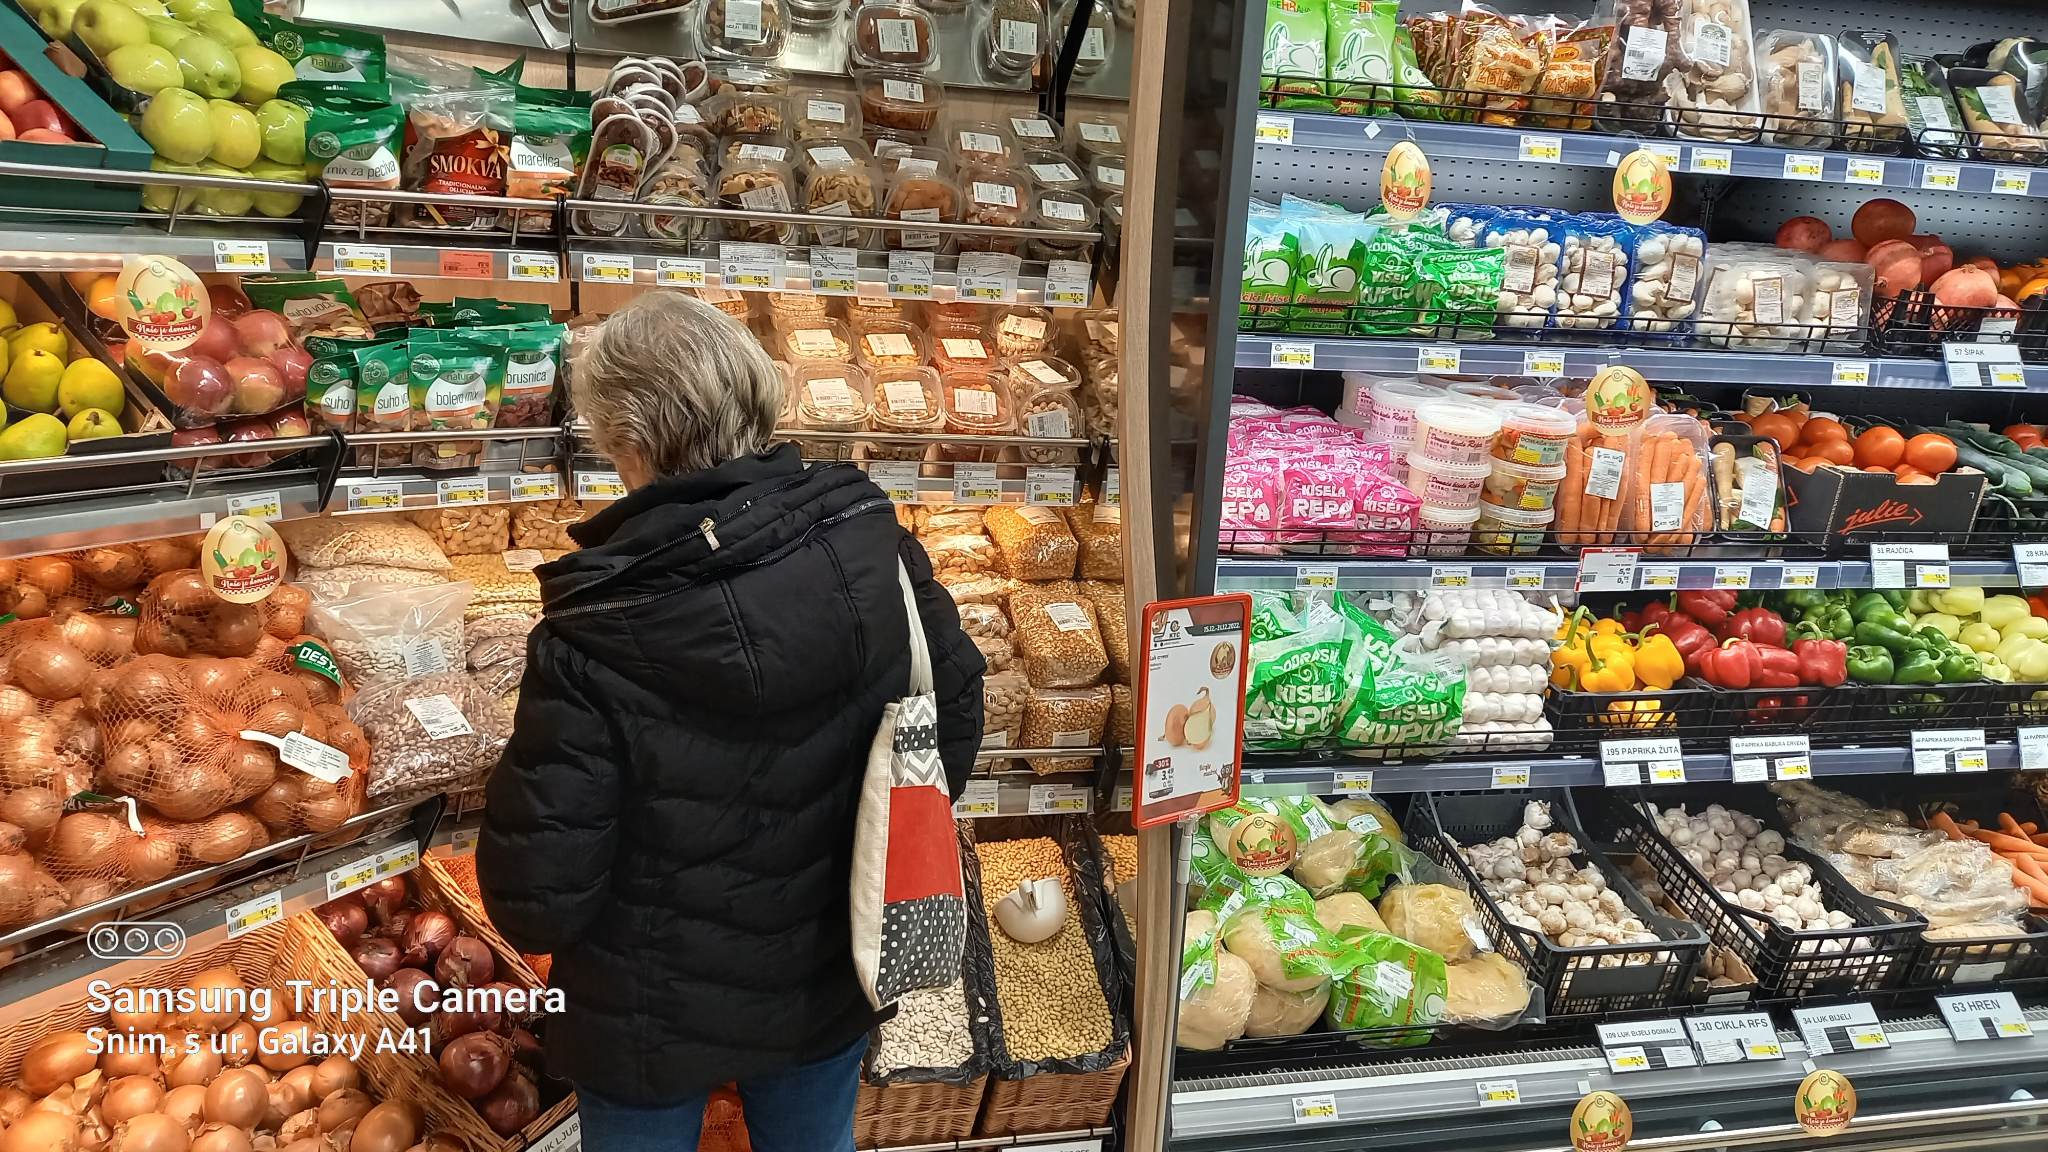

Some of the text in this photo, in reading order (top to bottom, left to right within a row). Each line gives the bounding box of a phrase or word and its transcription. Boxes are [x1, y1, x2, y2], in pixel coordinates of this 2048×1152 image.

[430, 154, 502, 180] SMOKVA
[517, 151, 560, 168] marelica
[327, 157, 396, 179] mix za peciva
[438, 179, 487, 191] TRADICIONALNA
[1963, 346, 1985, 356] ŠIPAK
[506, 370, 547, 384] brusnica
[324, 395, 350, 410] suho
[377, 394, 399, 410] suho
[436, 390, 479, 406] bolero mix
[1301, 484, 1346, 498] KISELA
[1292, 498, 1354, 519] REPA
[1363, 499, 1411, 514] KISELA
[1845, 499, 1909, 528] julie
[1356, 513, 1411, 531] REPA
[1606, 743, 1680, 757] 195 PAPRIKA ŽUTA
[1951, 999, 2000, 1014] 63 HREN
[1694, 1017, 1769, 1032] 130 CIKLA RFS
[1802, 1013, 1852, 1025] 34 LUK BIJELI
[1617, 1030, 1629, 1038] LUK
[555, 1119, 581, 1145] LJUB
